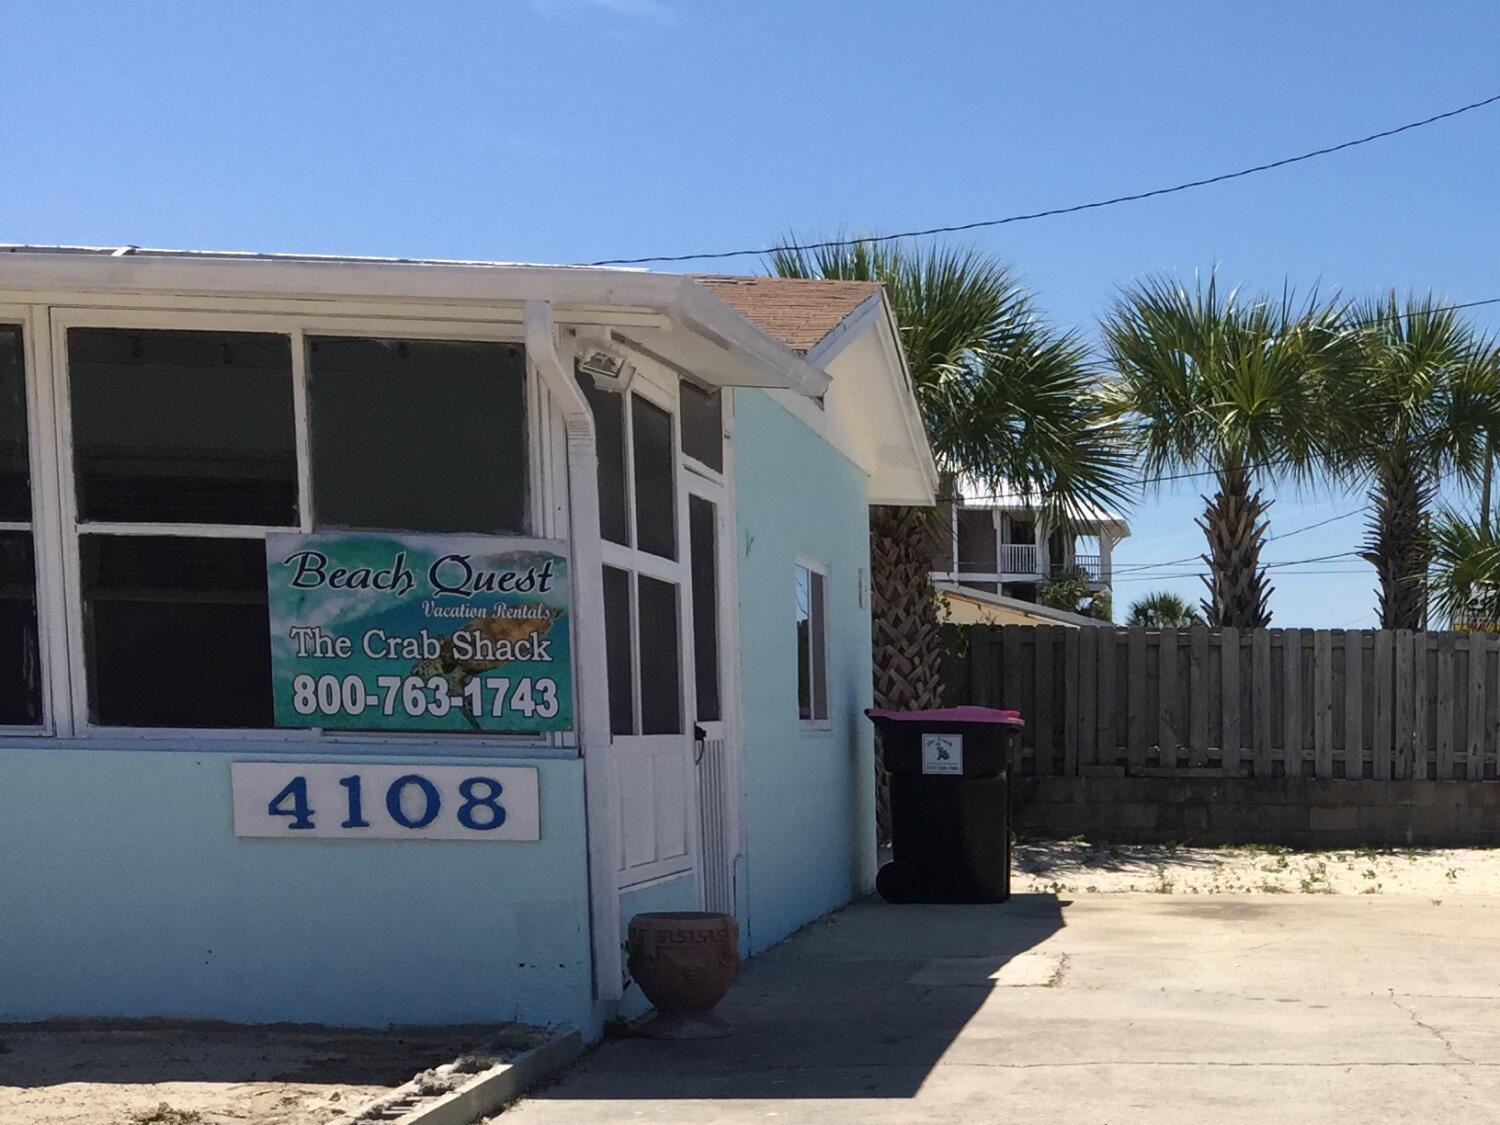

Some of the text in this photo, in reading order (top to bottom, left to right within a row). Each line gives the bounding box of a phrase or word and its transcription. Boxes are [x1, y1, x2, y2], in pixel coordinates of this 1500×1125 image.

[284, 551, 554, 597] Beach Quest
[422, 600, 552, 620] Vacation Rentals
[289, 627, 553, 662] The Crab Shack
[292, 673, 560, 719] 800-763-1743
[268, 773, 507, 831] 4108
